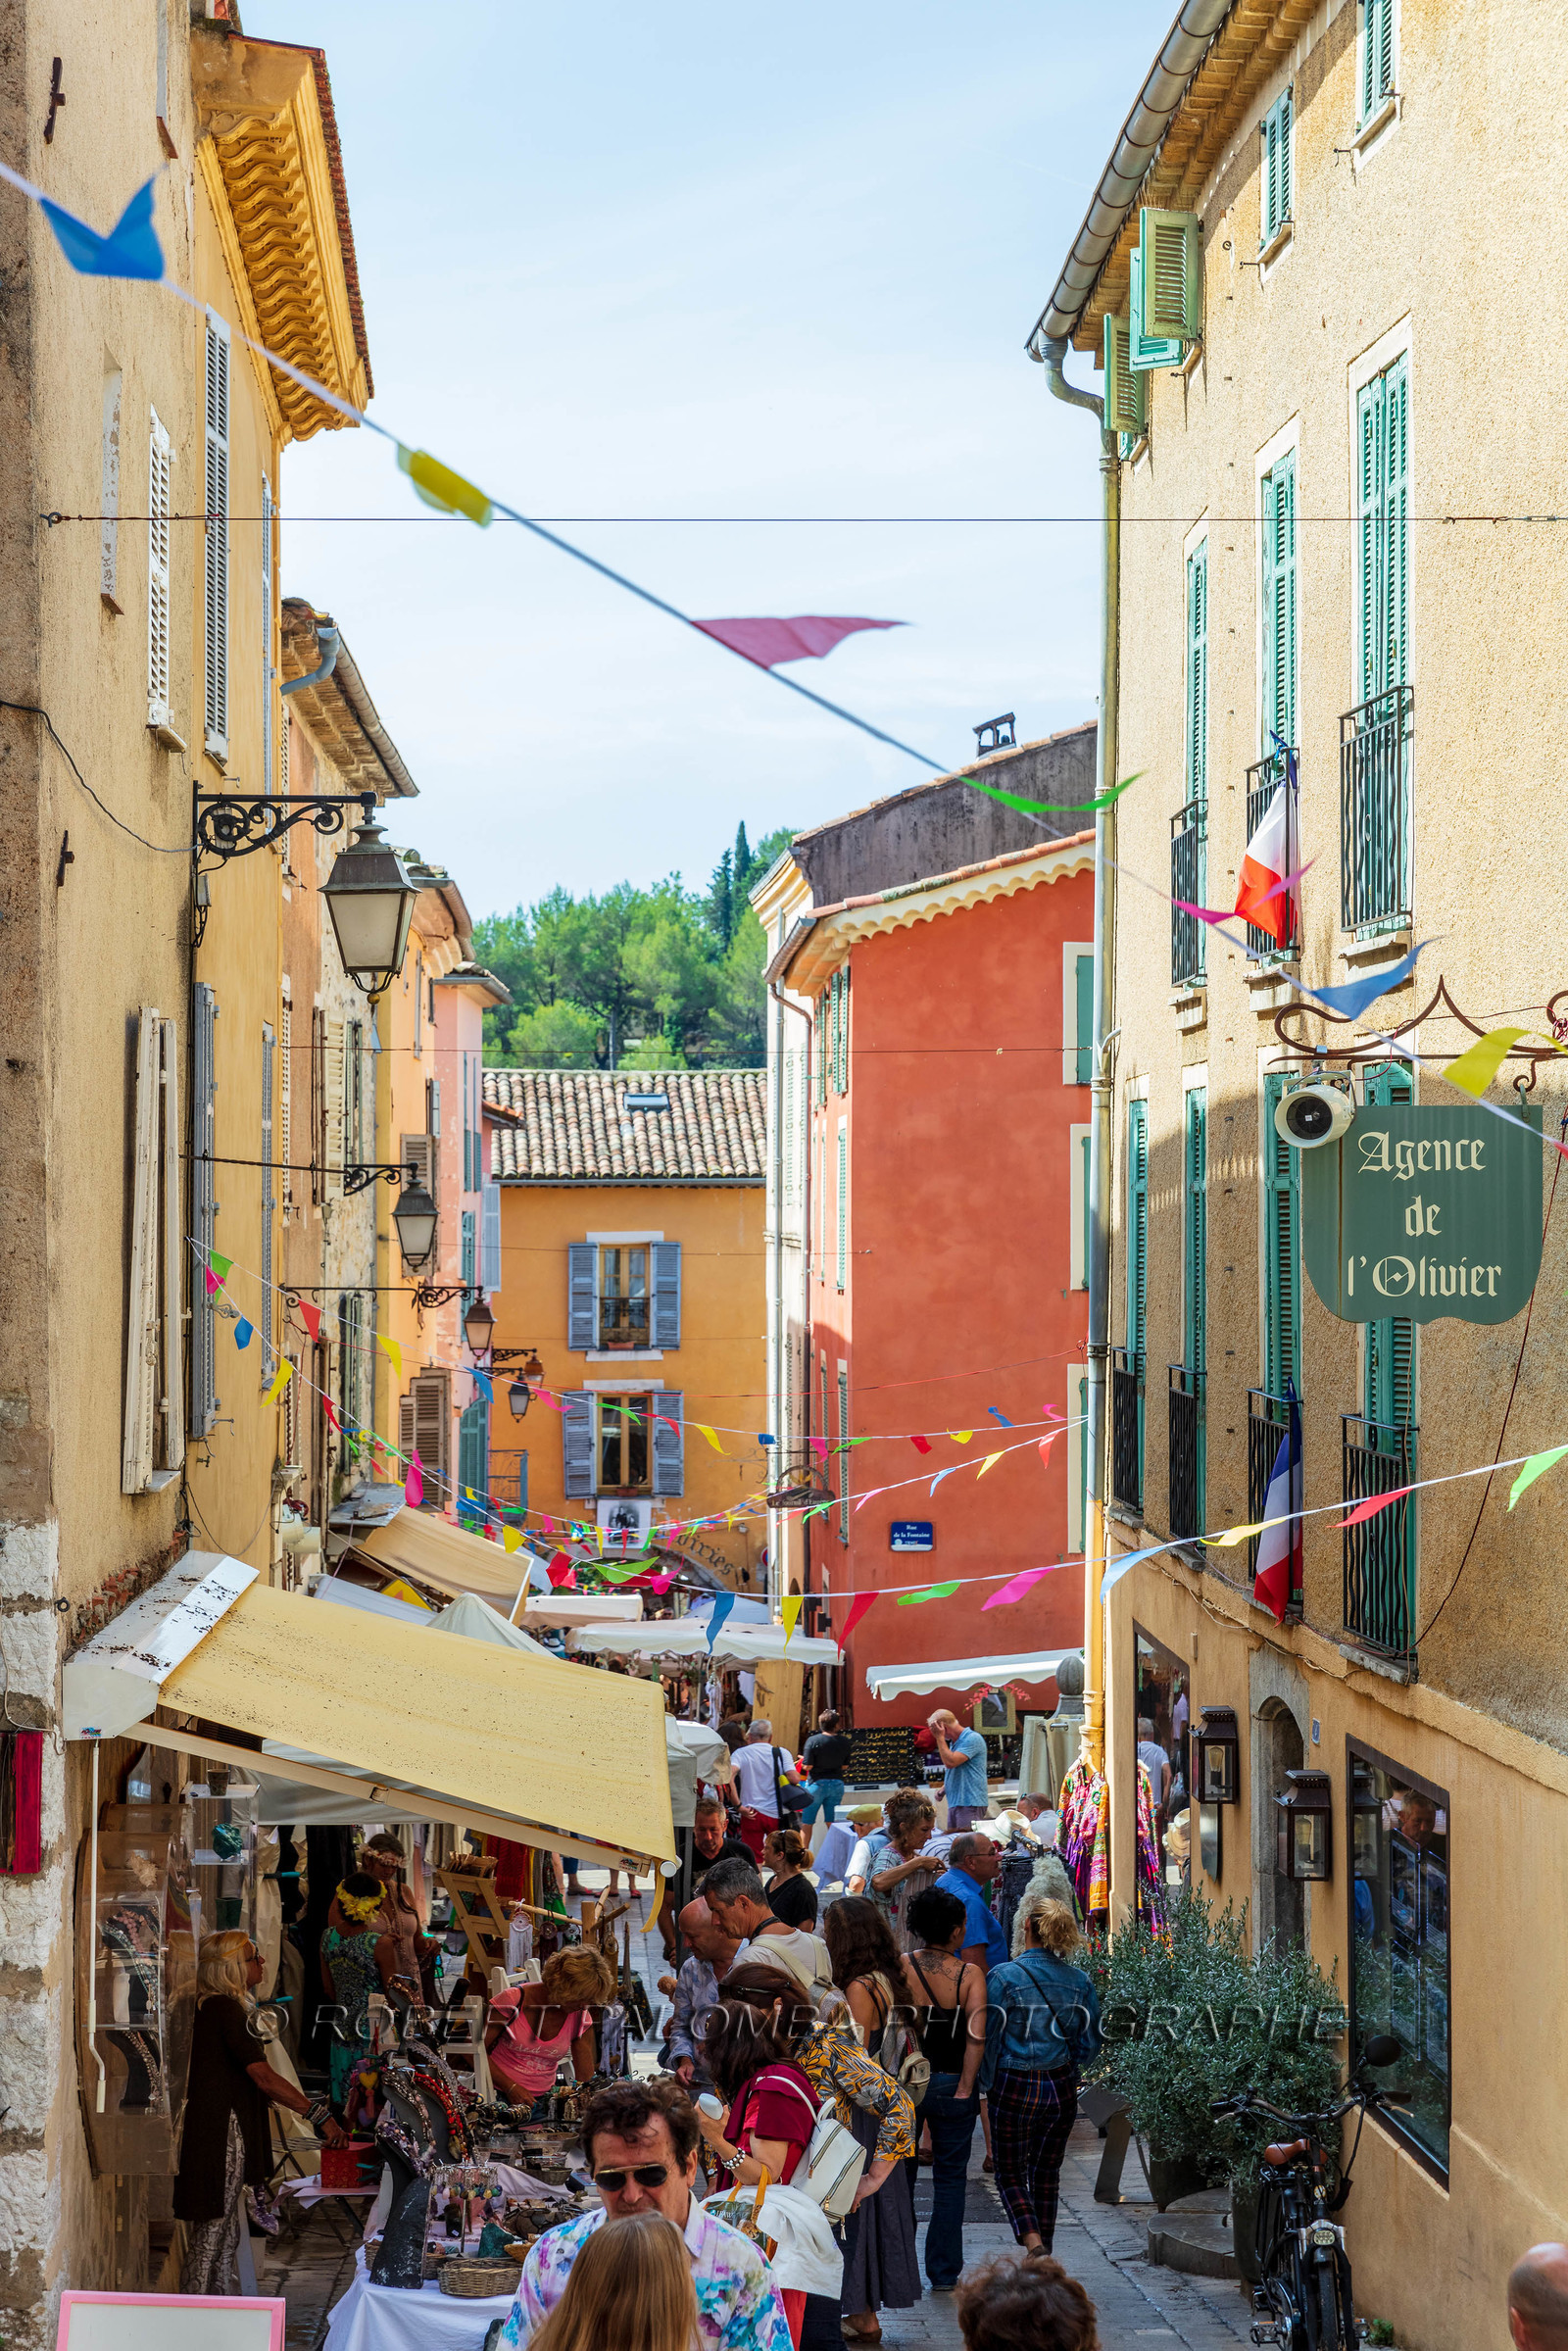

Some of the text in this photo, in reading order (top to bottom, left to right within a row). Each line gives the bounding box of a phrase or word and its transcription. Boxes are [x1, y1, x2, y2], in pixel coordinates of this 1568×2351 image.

[1357, 1131, 1486, 1182] Agence
[1404, 1195, 1442, 1238] de
[1348, 1254, 1502, 1298] l'Olivier
